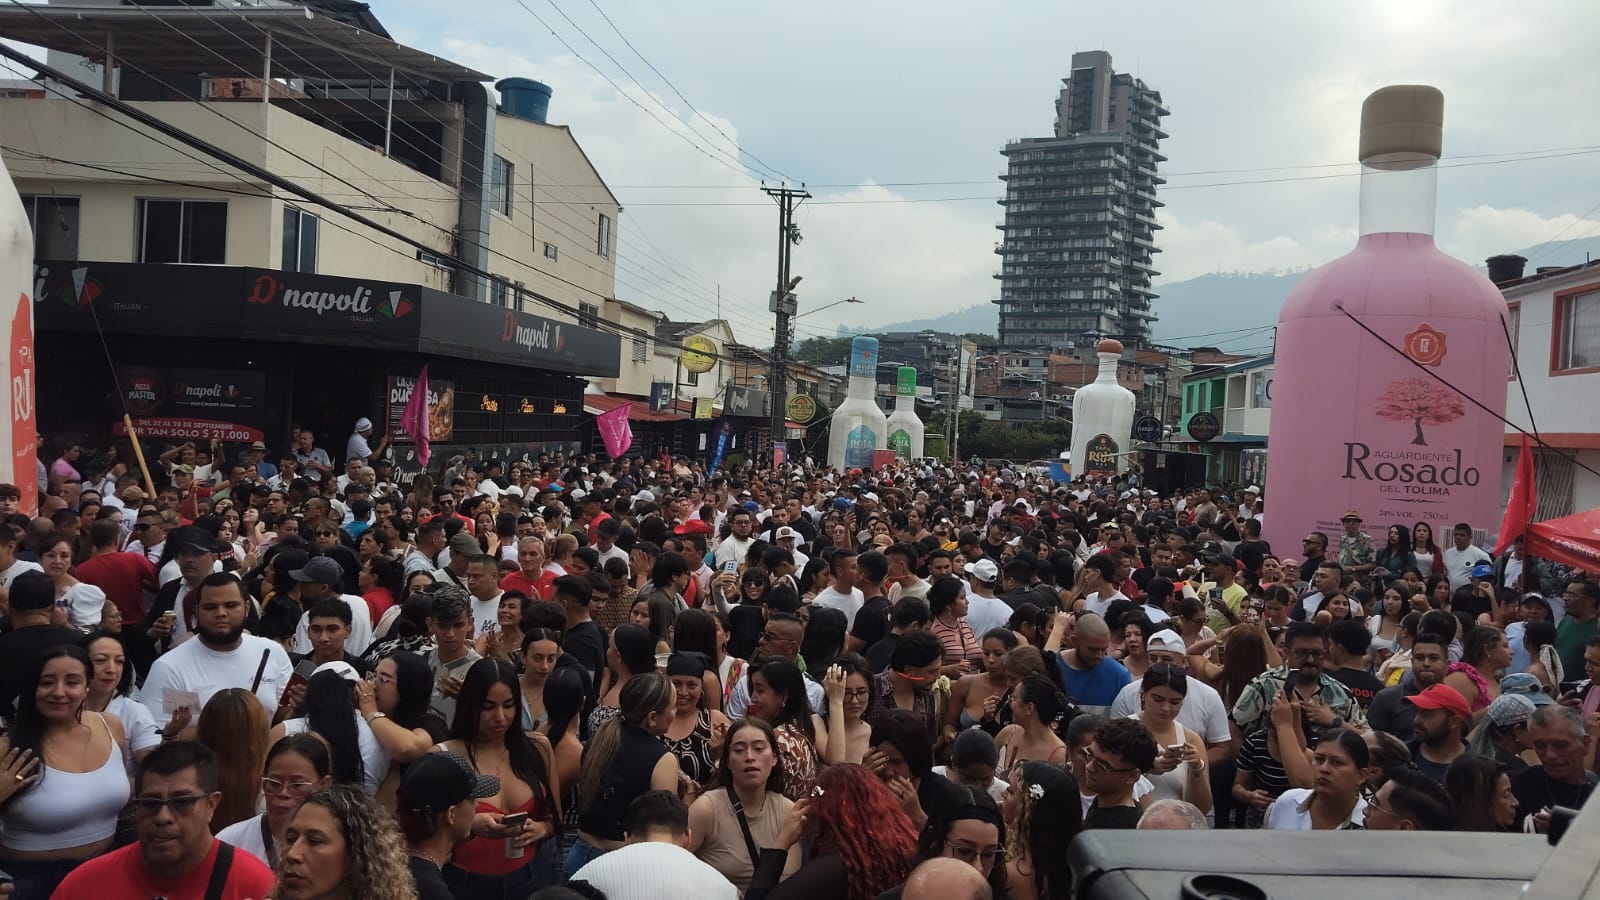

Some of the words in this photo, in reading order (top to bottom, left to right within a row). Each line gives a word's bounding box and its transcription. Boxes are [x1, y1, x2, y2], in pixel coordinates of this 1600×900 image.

[248, 274, 373, 315] D'napoli
[502, 309, 550, 352] D'napoli
[129, 391, 156, 400] MASTER
[139, 419, 152, 427] DEL
[163, 420, 172, 428] AL
[183, 421, 192, 429] DE
[193, 422, 234, 431] SEPTIEMBRE
[147, 427, 168, 436] TAN
[171, 428, 200, 438] SOLO
[202, 429, 209, 439] $
[213, 430, 251, 441] 21.000
[850, 439, 873, 449] ROJA
[1375, 451, 1452, 462] AGUARDIENTE
[1341, 442, 1480, 487] Rosado
[1379, 485, 1401, 494] DEL
[1405, 485, 1450, 496] TOLIMA
